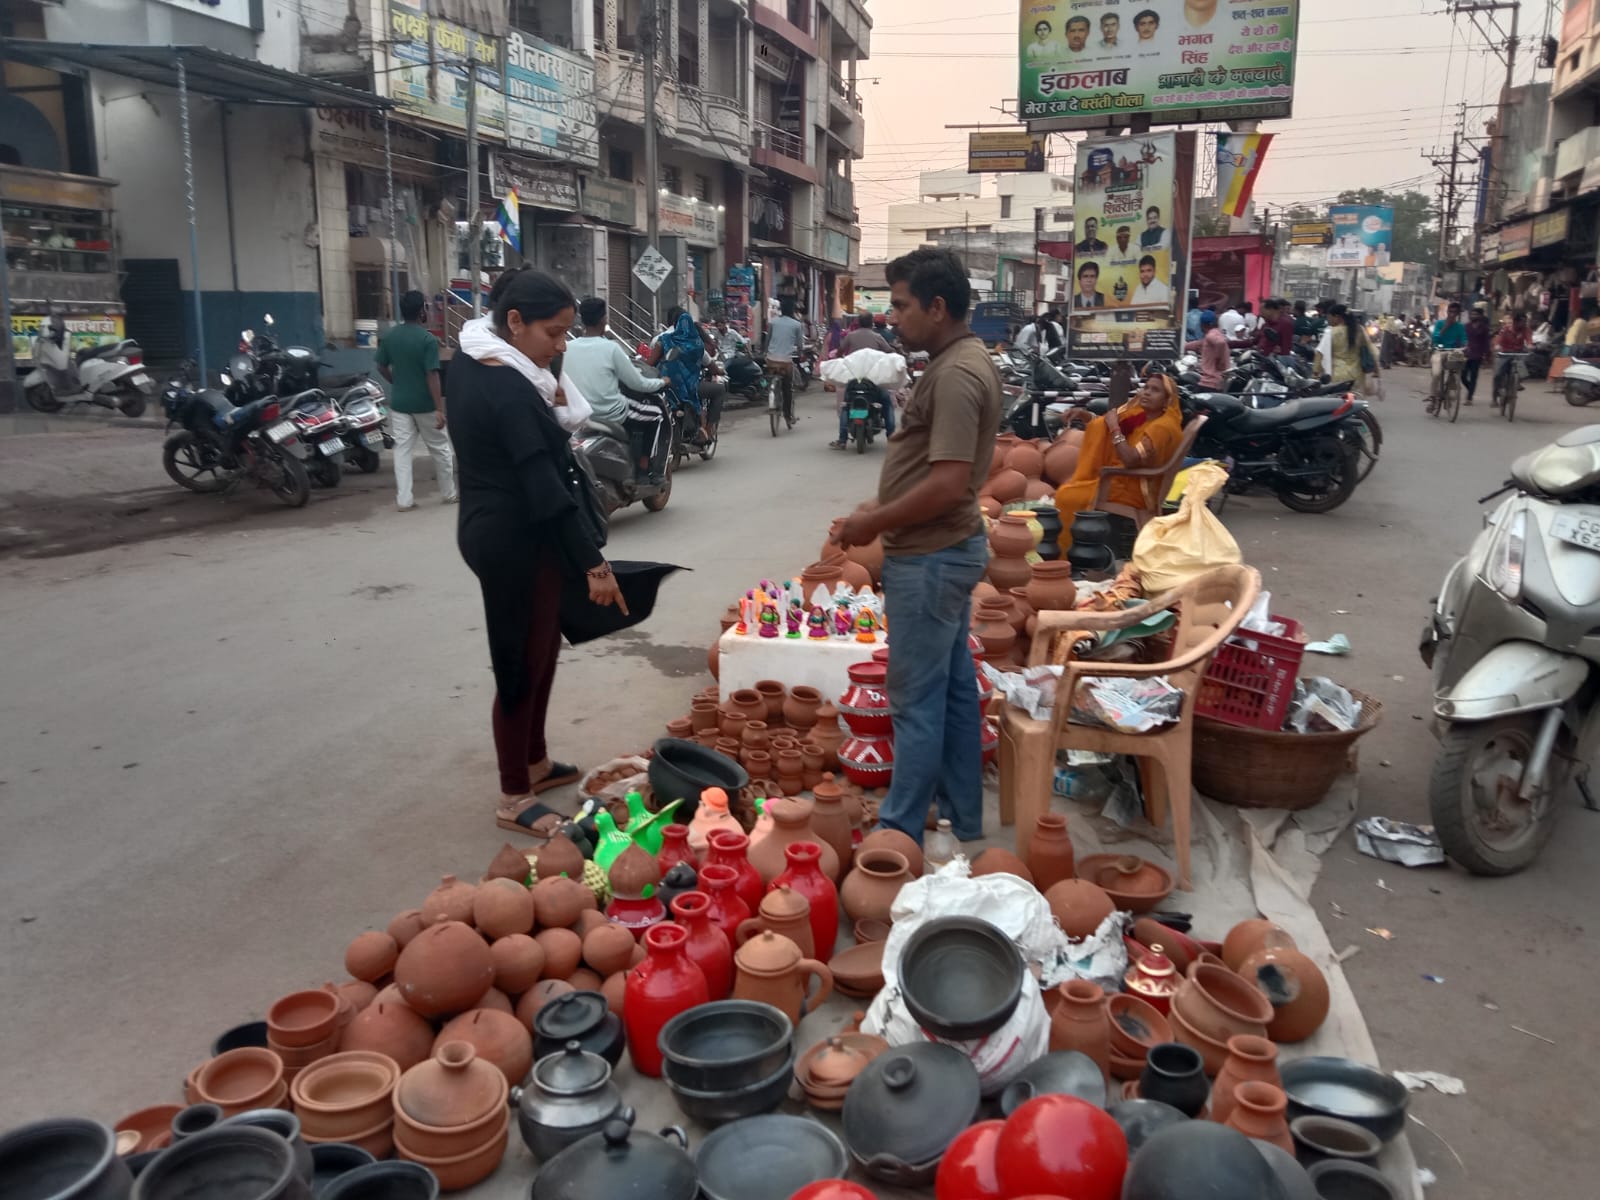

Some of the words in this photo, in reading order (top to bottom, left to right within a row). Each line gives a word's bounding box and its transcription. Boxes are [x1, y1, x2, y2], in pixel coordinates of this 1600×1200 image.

[1178, 33, 1213, 46] भगत
[1180, 49, 1209, 65] सिंह
[1039, 67, 1131, 95] इंकलाब
[1158, 69, 1204, 89] आजादी
[1209, 65, 1227, 84] के
[1230, 62, 1285, 83] मतवाले
[509, 77, 559, 113] DELUXE
[561, 93, 596, 125] SHOES
[1025, 100, 1047, 114] मेरा
[1049, 99, 1067, 112] रंग
[1068, 97, 1079, 111] दे
[1080, 94, 1112, 110] बसंती
